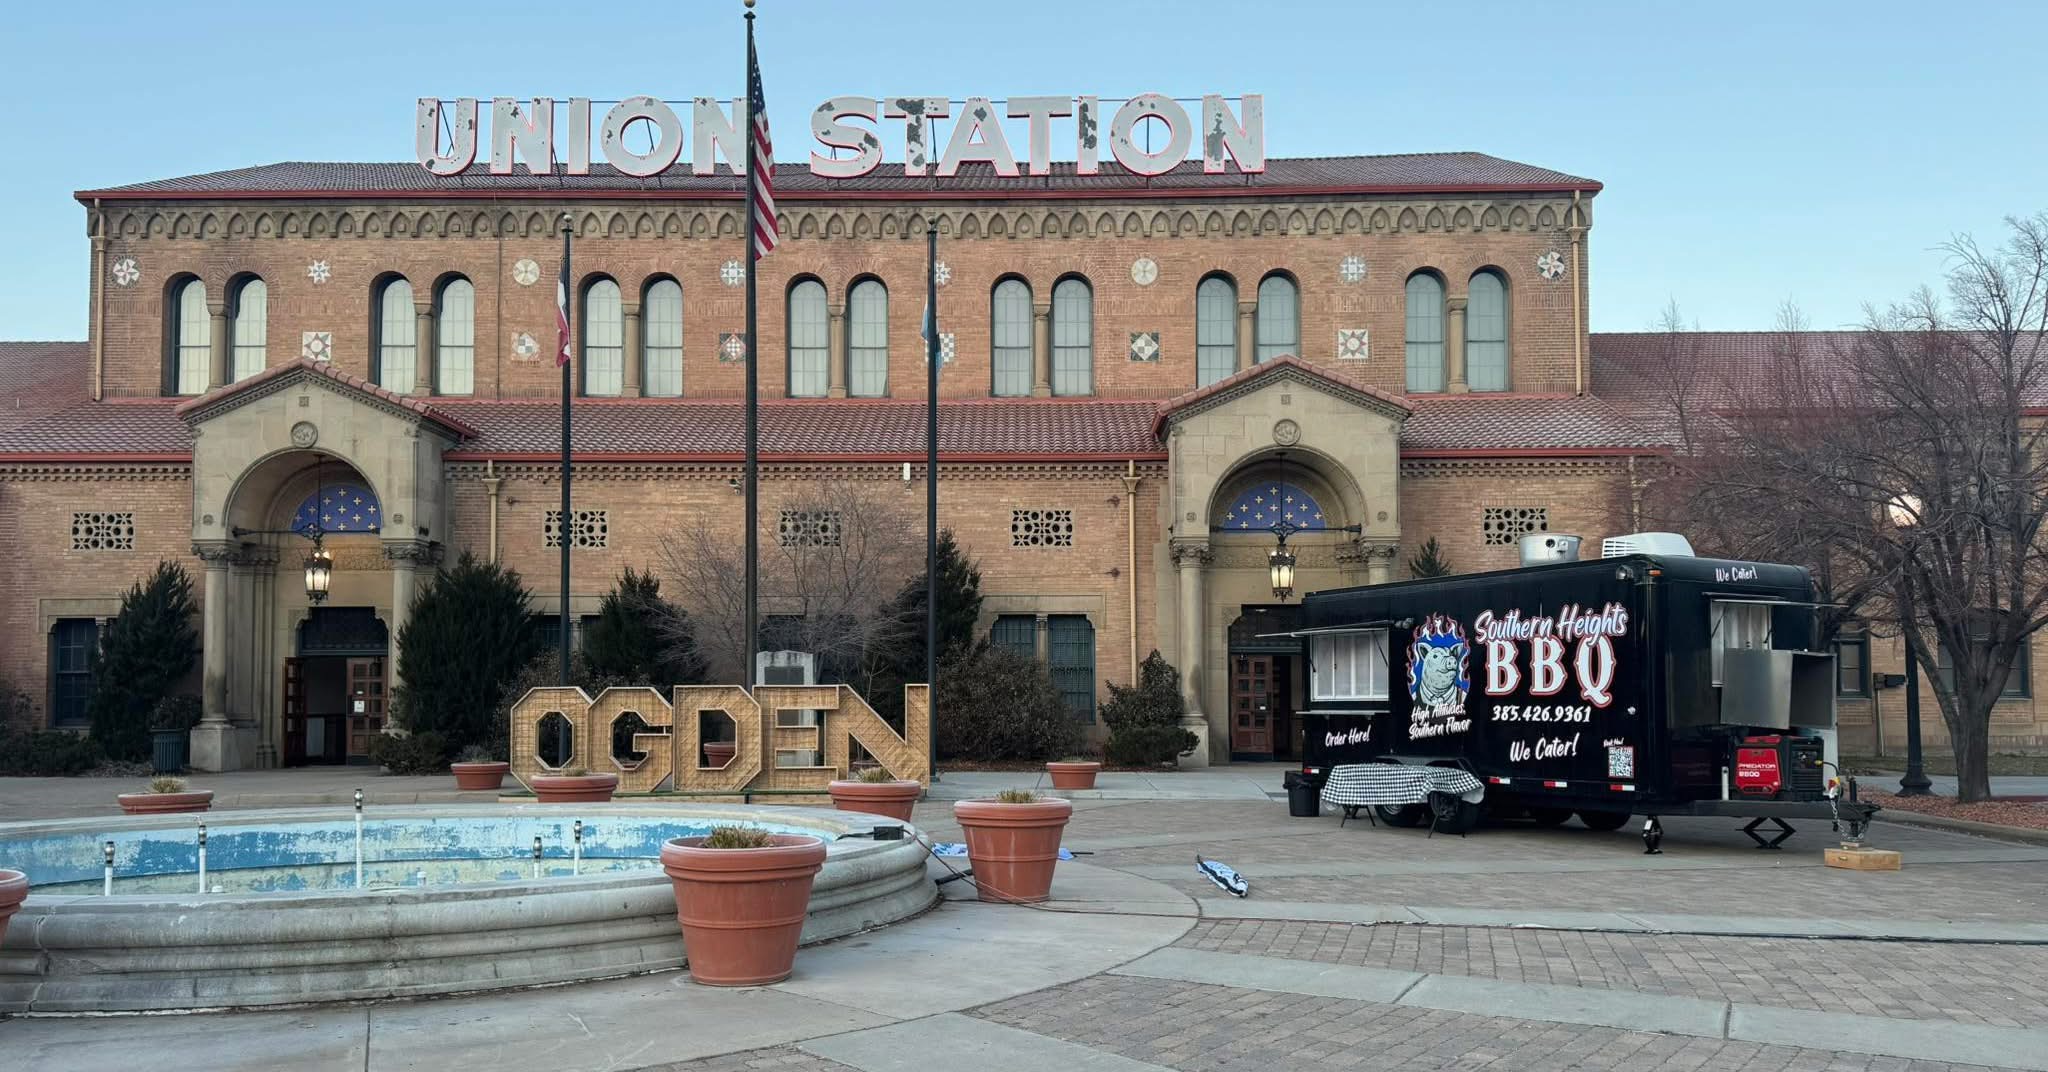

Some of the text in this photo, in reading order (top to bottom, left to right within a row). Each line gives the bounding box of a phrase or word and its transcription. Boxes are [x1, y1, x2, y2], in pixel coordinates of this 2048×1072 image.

[416, 93, 1266, 177] UNION STATION
[1715, 565, 1758, 582] We Cater!
[1475, 601, 1629, 648] Southern Heights
[1485, 634, 1617, 708] BBQ
[1411, 704, 1430, 726] High
[1491, 704, 1592, 723] 385.426.9361
[510, 683, 930, 793] OGDEN
[1325, 724, 1372, 747] Order Here!
[1408, 716, 1472, 740] Southern Flavor
[1509, 732, 1580, 762] We Cater!
